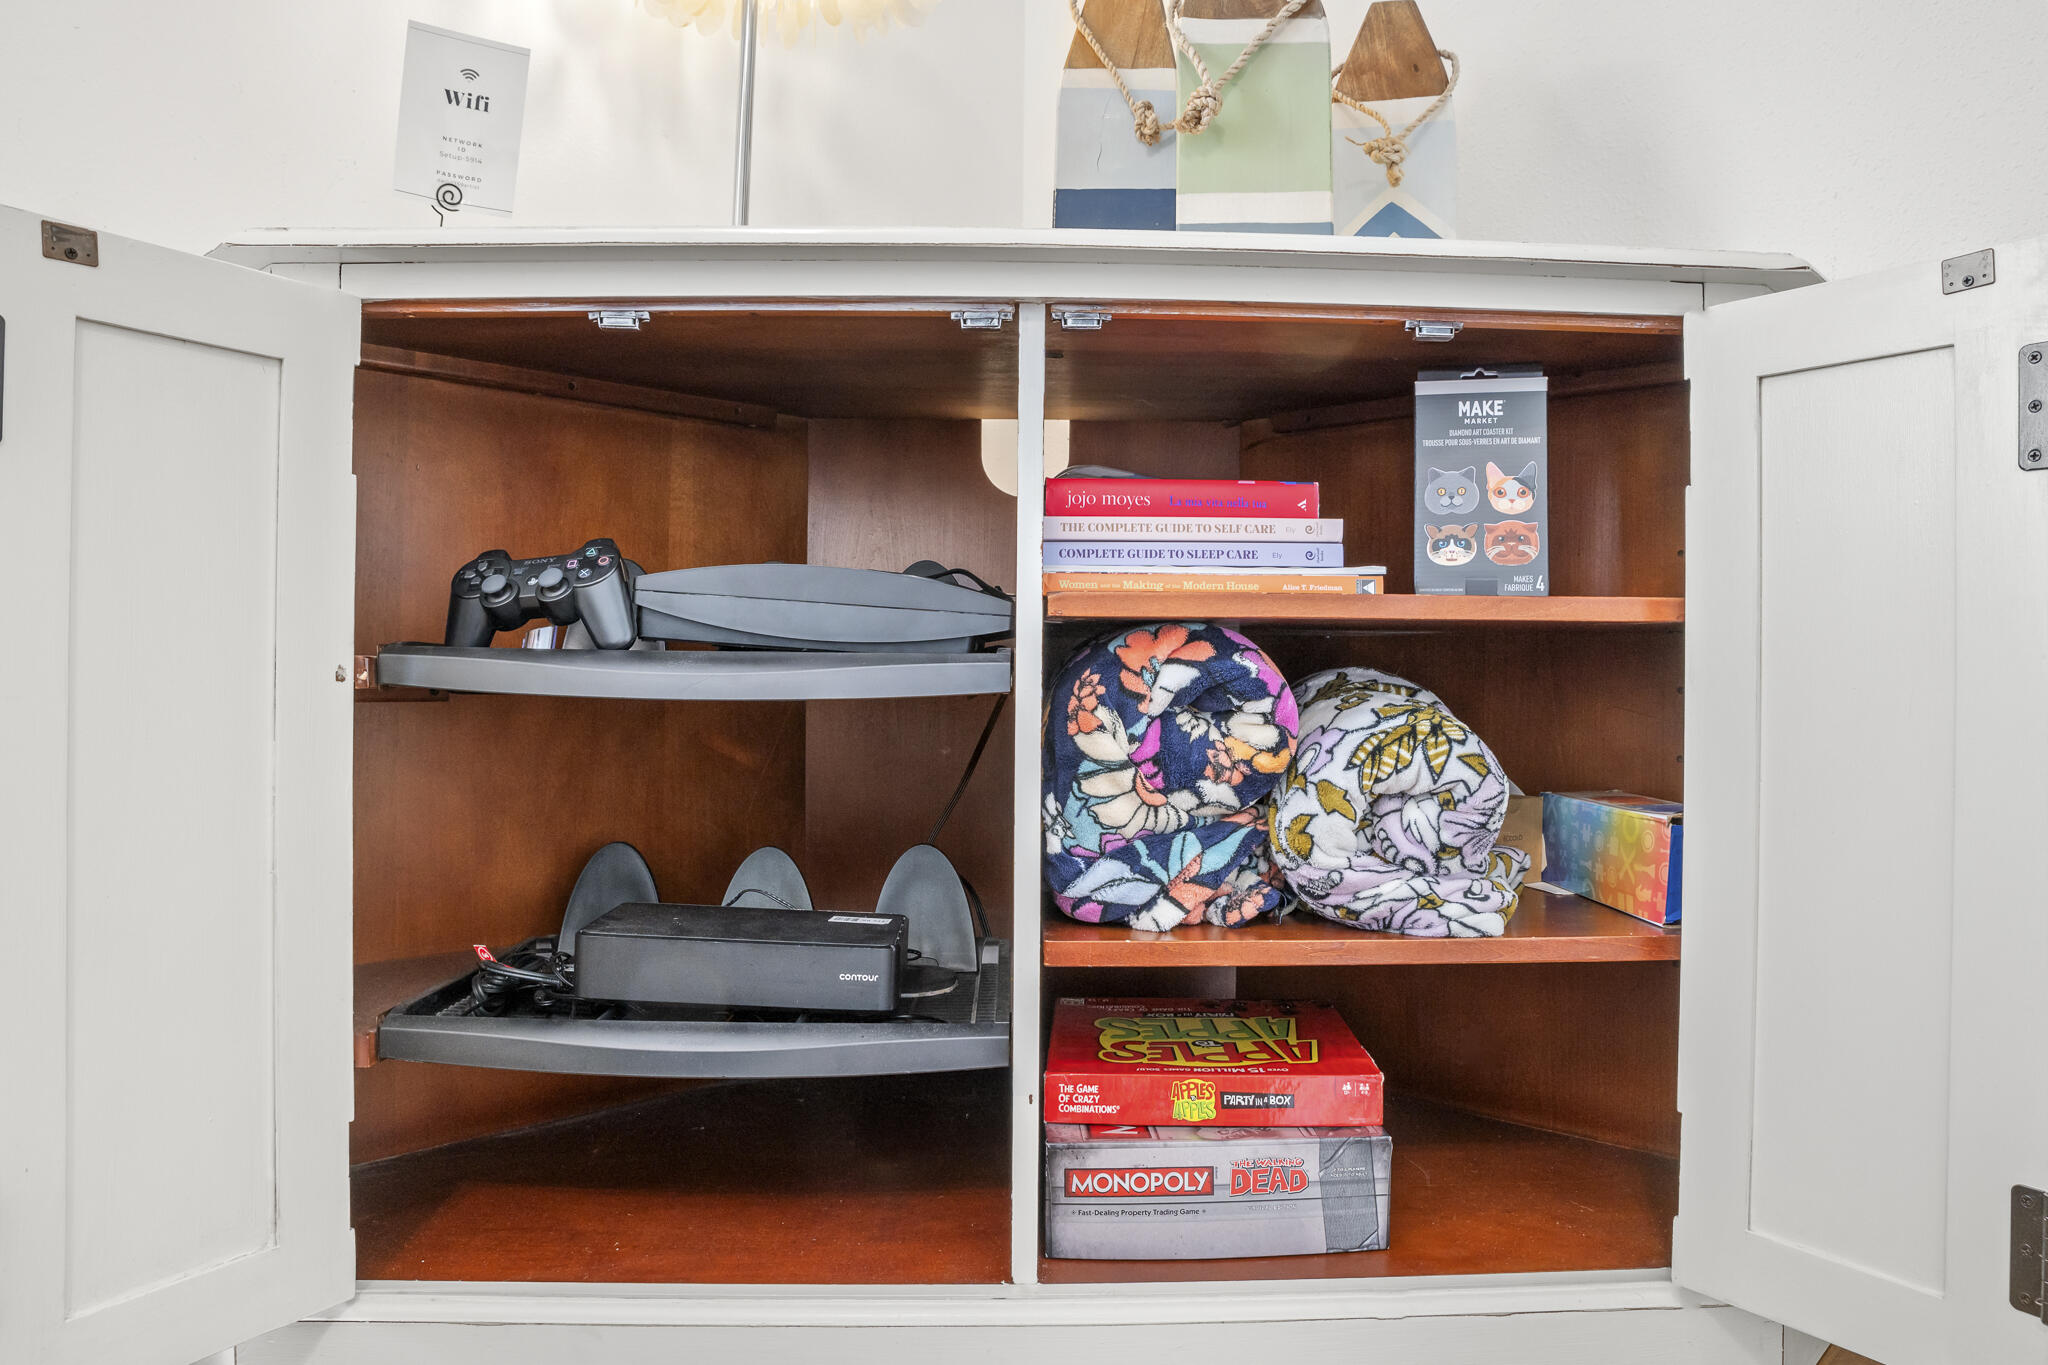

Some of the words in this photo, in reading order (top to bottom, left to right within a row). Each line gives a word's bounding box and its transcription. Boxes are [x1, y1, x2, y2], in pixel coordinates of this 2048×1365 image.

[444, 88, 490, 112] Wifi
[442, 136, 482, 148] NETWORK
[436, 170, 482, 182] PASSWORD
[1458, 400, 1504, 416] MAKE
[1472, 428, 1482, 436] ART
[1505, 427, 1513, 435] KIT
[1423, 439, 1444, 447] TROUSSE
[1518, 436, 1541, 444] DIAMANT
[1066, 490, 1096, 508] jojo
[1102, 494, 1151, 510] moyes
[1170, 495, 1182, 506] La
[1185, 497, 1202, 506] mia
[1206, 497, 1223, 507] vita
[1226, 497, 1249, 508] nella
[1252, 499, 1267, 508] tua
[1060, 522, 1085, 532] THE
[1088, 523, 1153, 532] COMPLETE
[1155, 523, 1193, 533] GUIDE
[1195, 524, 1212, 533] TO
[1214, 524, 1242, 533] SELF
[1244, 524, 1276, 534] CARE
[1058, 548, 1124, 559] COMPLETE
[1127, 549, 1165, 559] GUIDE
[1168, 549, 1184, 559] TO
[1186, 549, 1224, 559] SLEEP
[1226, 550, 1258, 559] CARE
[524, 557, 556, 565] SONY
[1059, 579, 1098, 589] Women
[1123, 580, 1163, 591] Making
[1183, 581, 1223, 590] Modern
[1226, 582, 1259, 590] House
[1504, 584, 1534, 592] FABRIQUE
[1536, 575, 1545, 591] 4
[1098, 1018, 1291, 1040] APPLES
[1102, 1040, 1313, 1063] APPLES
[1059, 1084, 1074, 1093] THE
[1076, 1084, 1099, 1094] GAME
[1172, 1082, 1215, 1100] APPLES
[1058, 1094, 1070, 1103] OF
[1072, 1094, 1100, 1104] CRAZY
[1224, 1094, 1254, 1106] PARTY
[1255, 1098, 1263, 1106] IN
[1270, 1095, 1291, 1105] BOX
[1173, 1101, 1215, 1119] APPLES
[1255, 1158, 1303, 1167] WALKING
[1071, 1172, 1209, 1193] MONOPOLY
[1230, 1167, 1309, 1196] DEAD
[1121, 1209, 1152, 1217] Property
[1153, 1209, 1178, 1217] Trading
